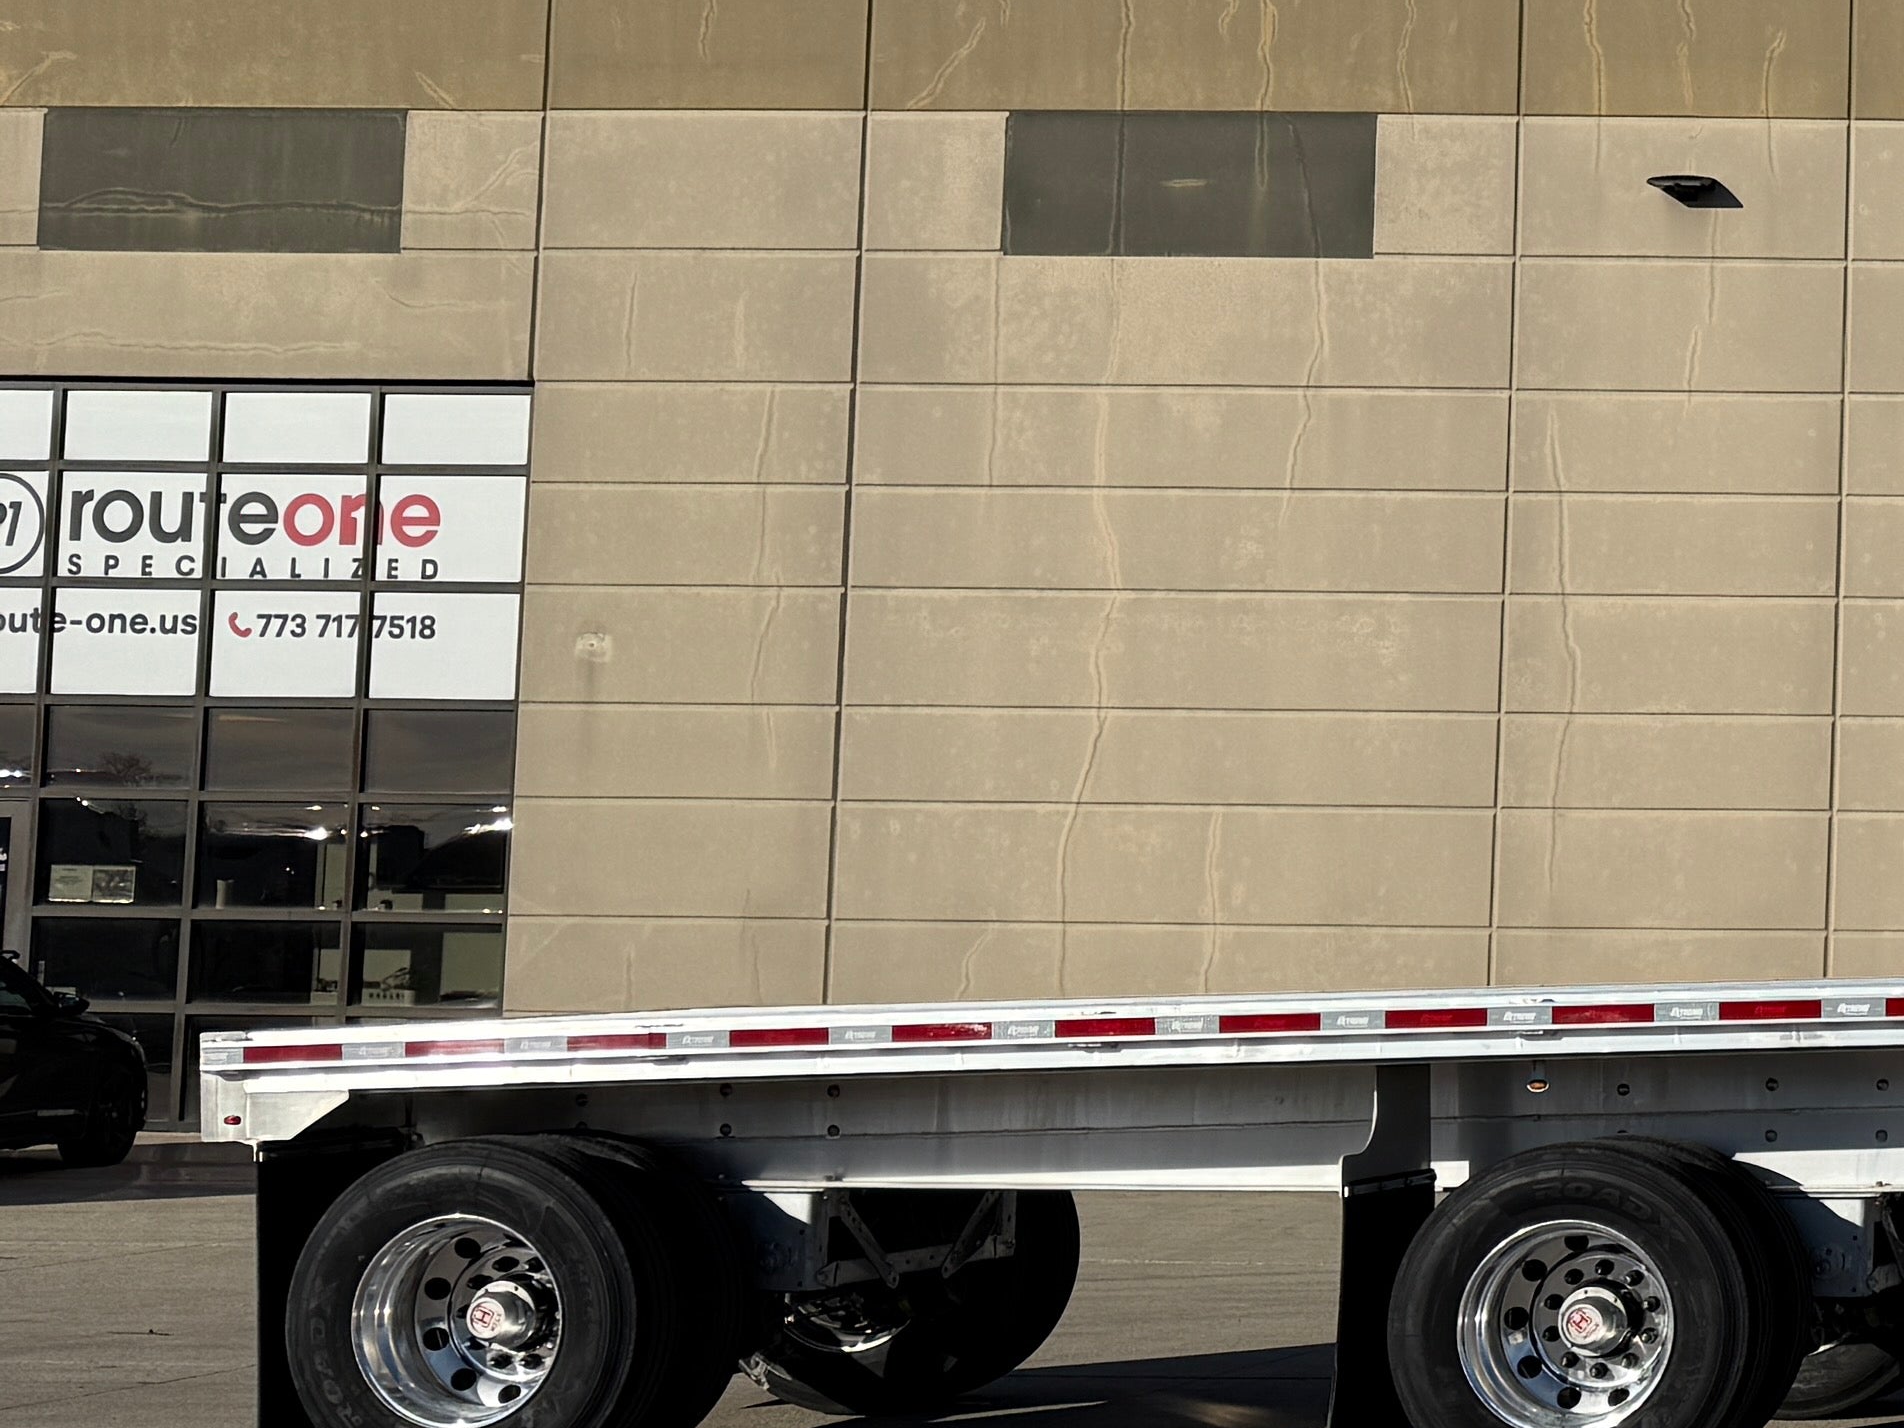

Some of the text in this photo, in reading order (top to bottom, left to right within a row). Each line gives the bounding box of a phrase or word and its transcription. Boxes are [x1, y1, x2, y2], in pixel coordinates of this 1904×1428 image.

[67, 553, 439, 580] SPECIALIZED
[256, 614, 307, 638] 773
[316, 614, 359, 639] 717
[373, 615, 437, 639] 7518
